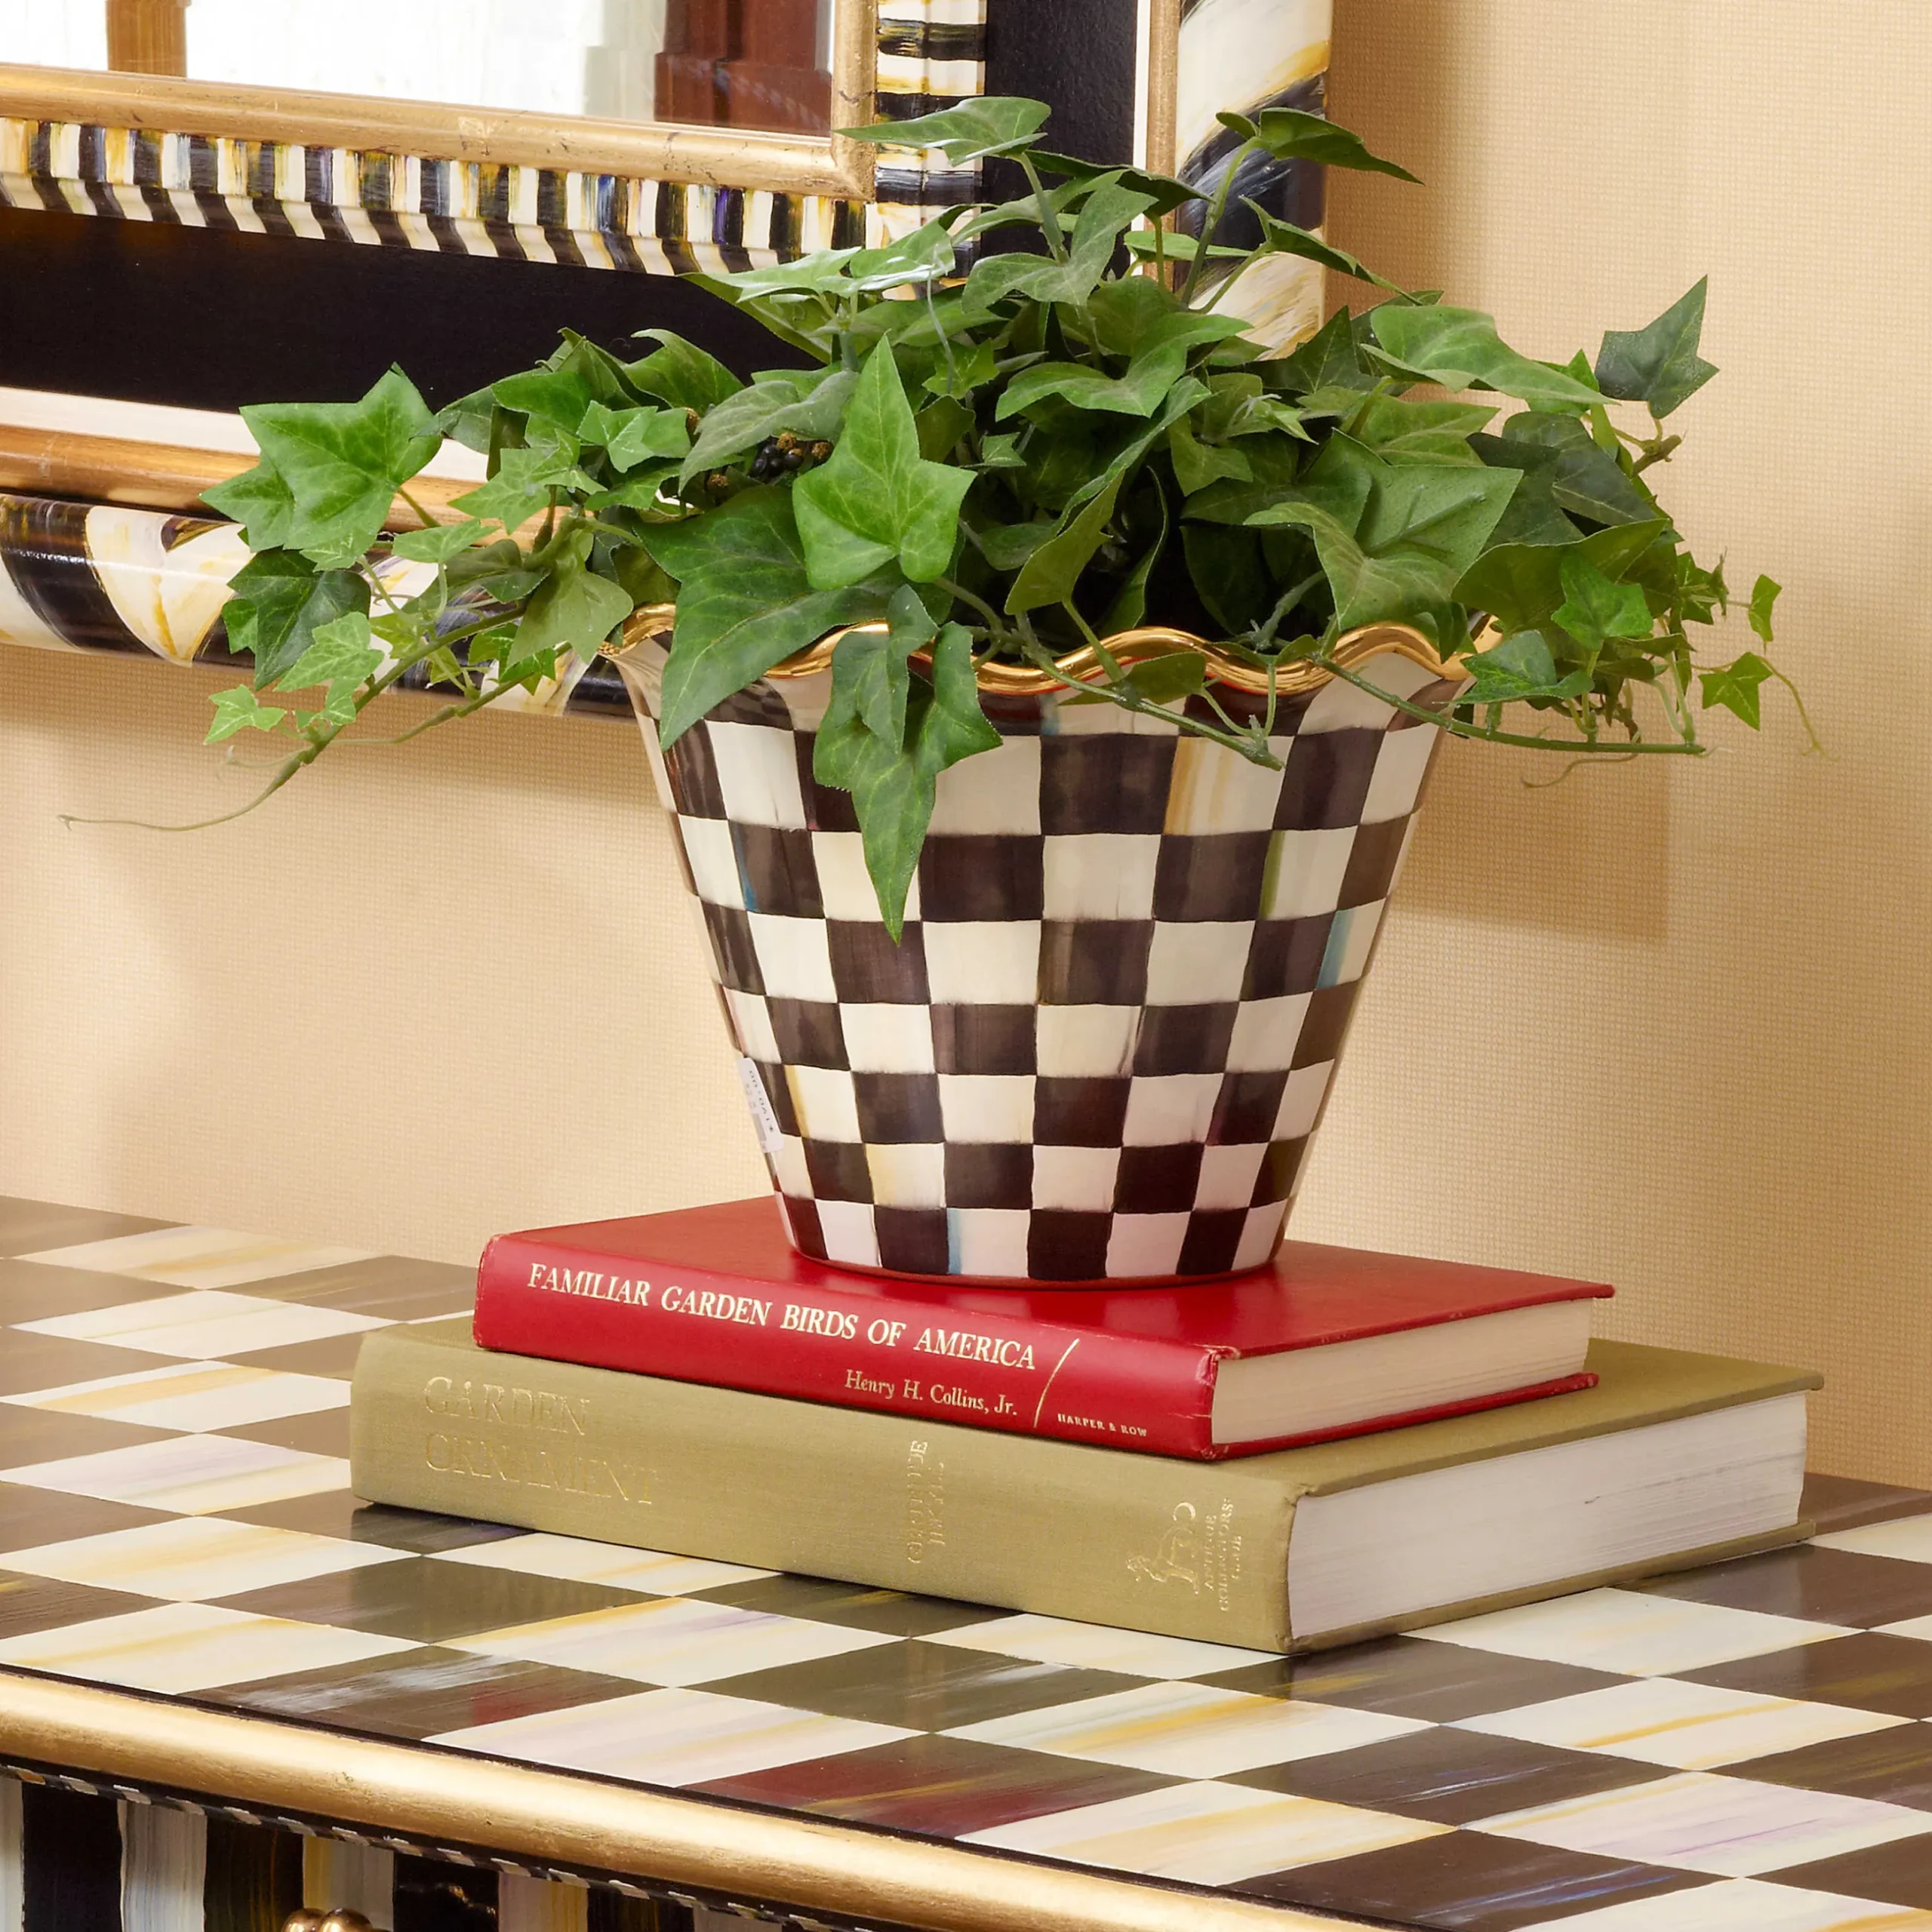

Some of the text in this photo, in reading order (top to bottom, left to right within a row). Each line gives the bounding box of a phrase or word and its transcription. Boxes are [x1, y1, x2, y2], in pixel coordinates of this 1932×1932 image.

[528, 1263, 1035, 1370] FAMILIAR GARDEN BIRDS OF AMERICA
[423, 1376, 590, 1435] GARDEN
[844, 1369, 1018, 1416] Henry H. Collins, Jr.
[1057, 1413, 1147, 1437] HARPER & ROW
